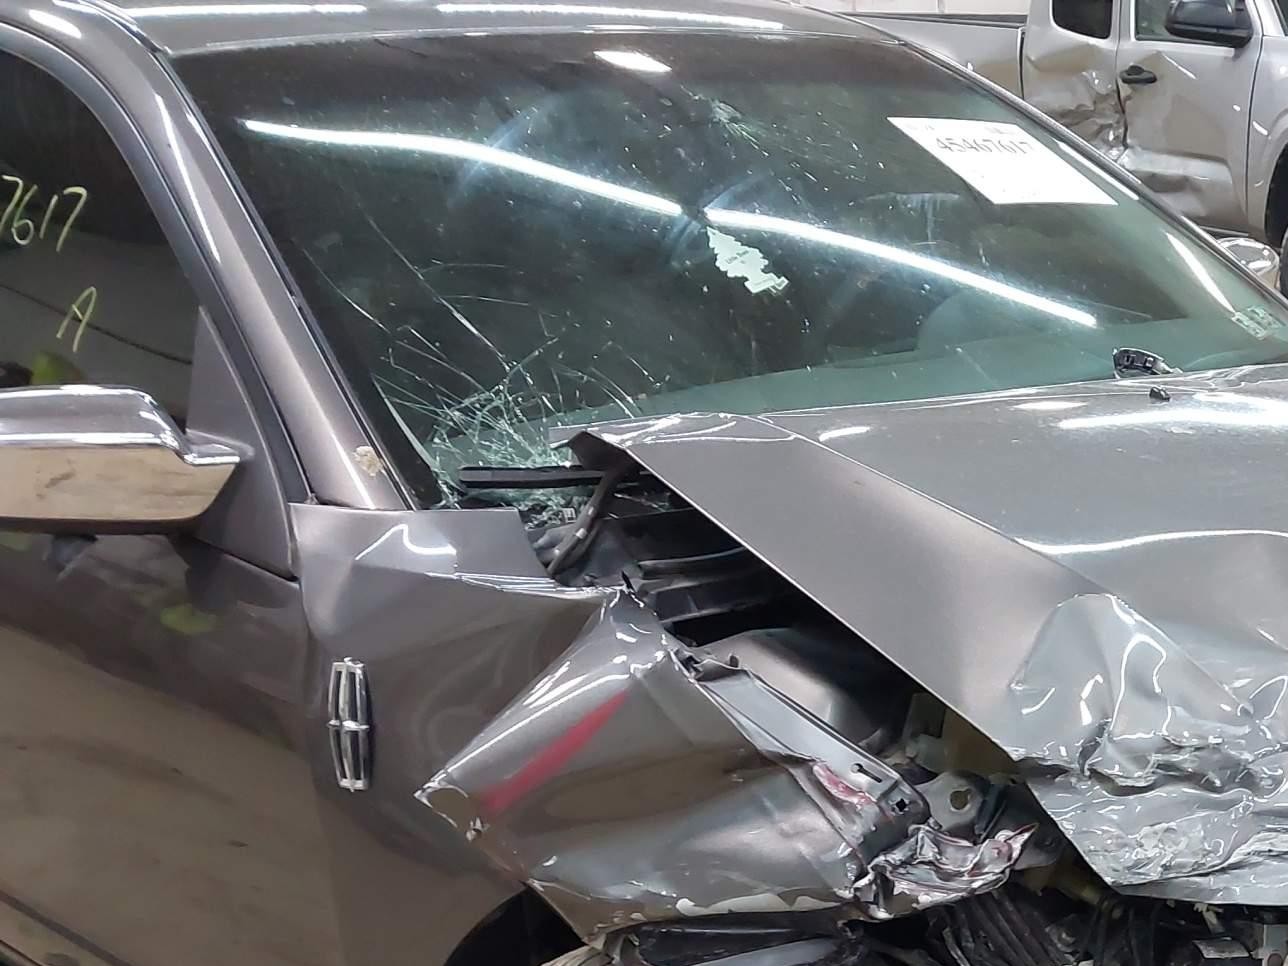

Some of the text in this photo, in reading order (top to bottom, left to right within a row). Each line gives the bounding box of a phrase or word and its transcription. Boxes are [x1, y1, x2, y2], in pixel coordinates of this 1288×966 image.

[935, 136, 1034, 155] 45467617
[0, 175, 88, 252] 7617
[56, 286, 97, 353] A
